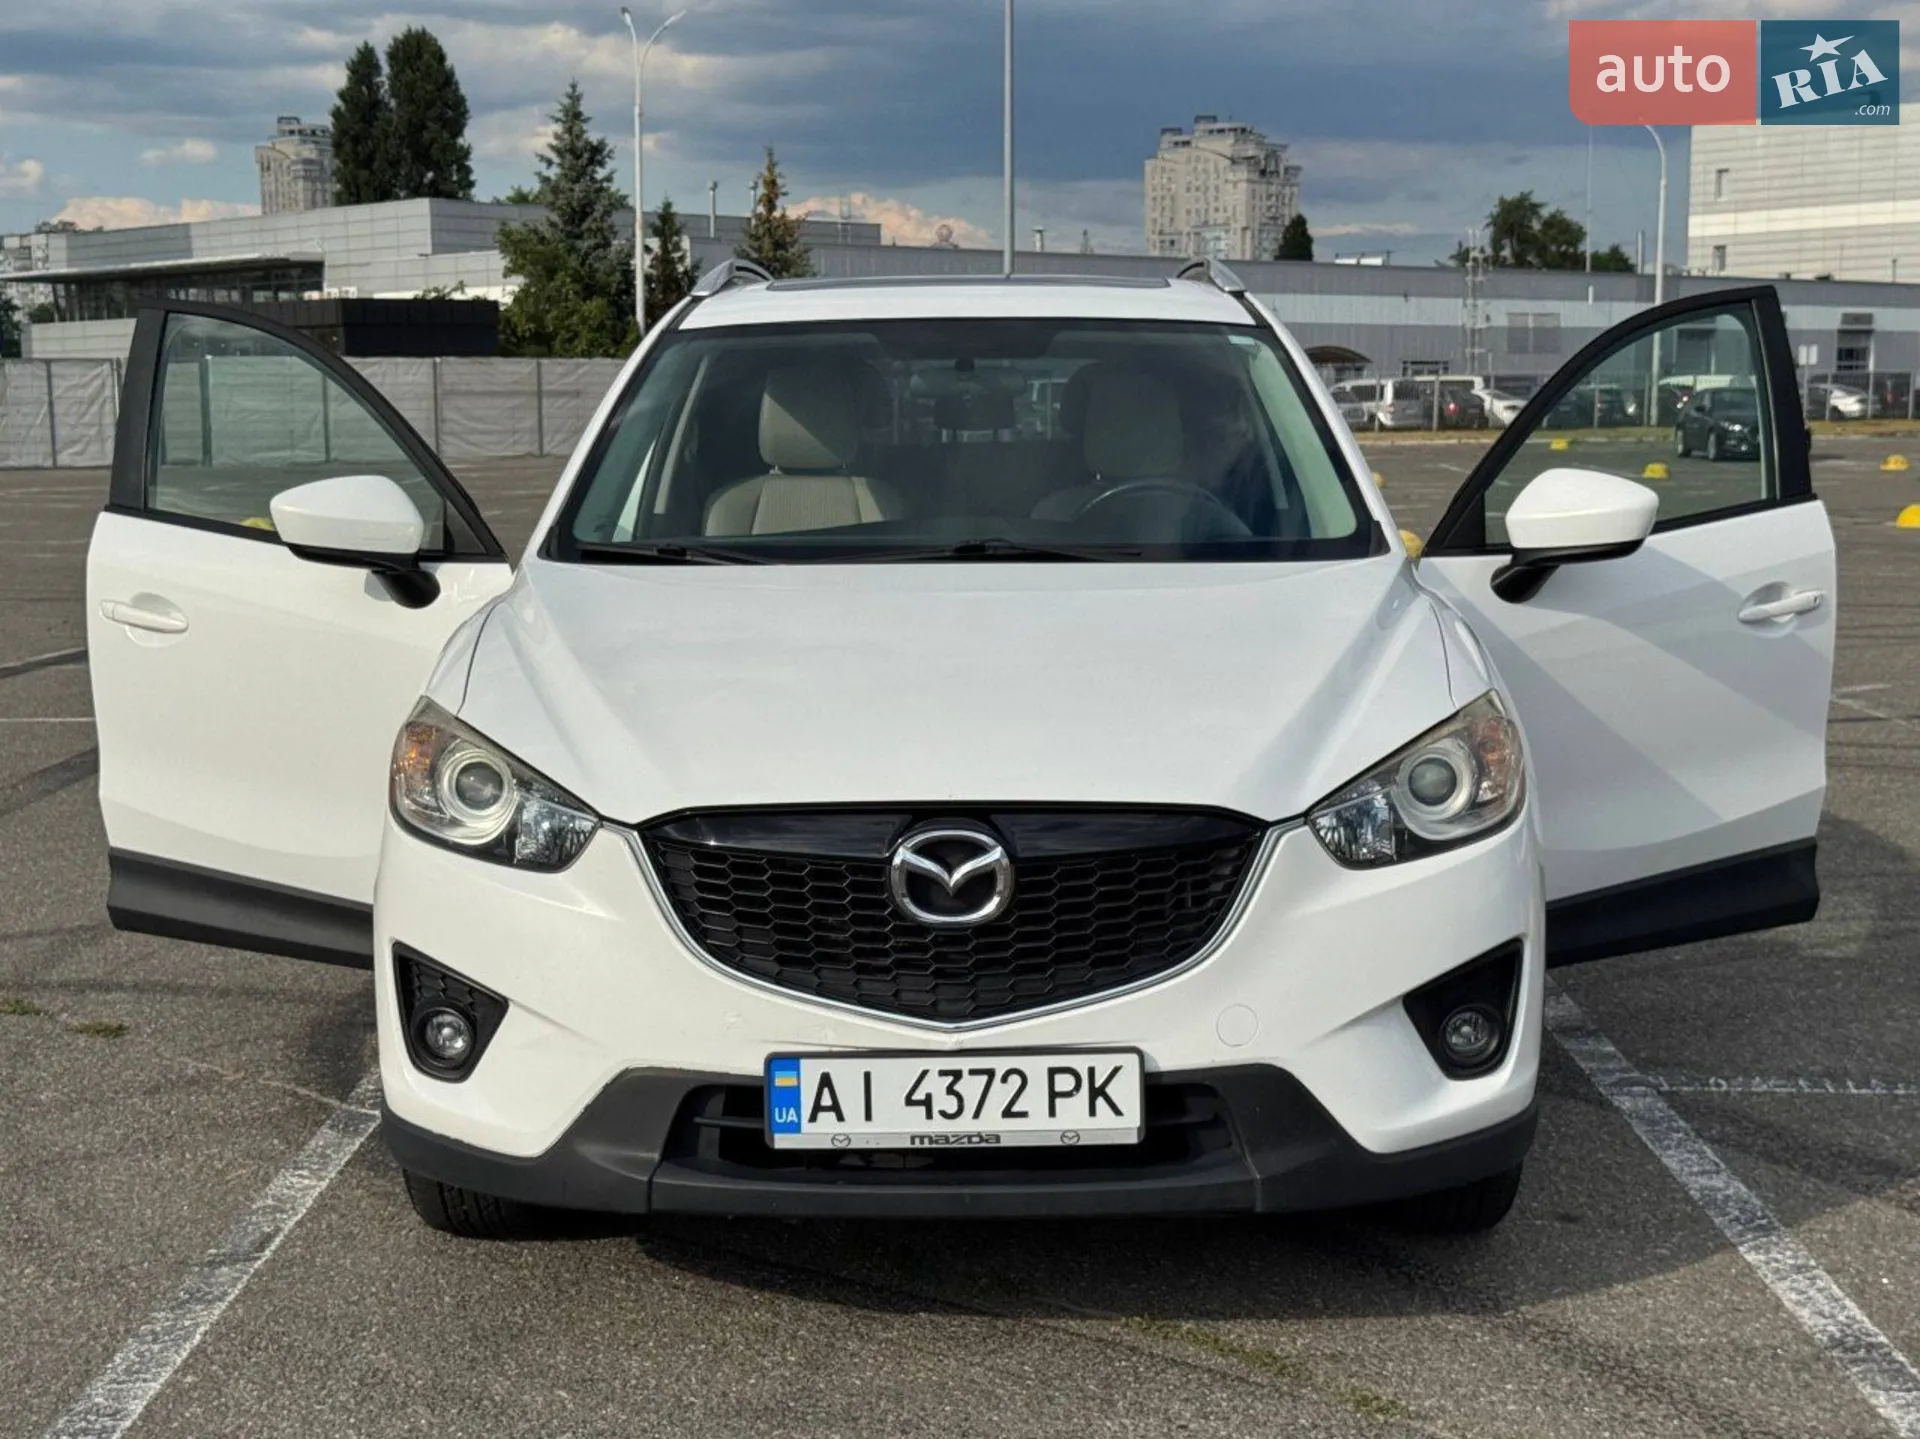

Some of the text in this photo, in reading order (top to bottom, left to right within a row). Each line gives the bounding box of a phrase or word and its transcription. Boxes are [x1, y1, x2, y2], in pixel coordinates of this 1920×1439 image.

[807, 1065, 1125, 1123] AI 4372 PK
[774, 1106, 799, 1124] UA
[909, 1132, 1002, 1147] mazda
